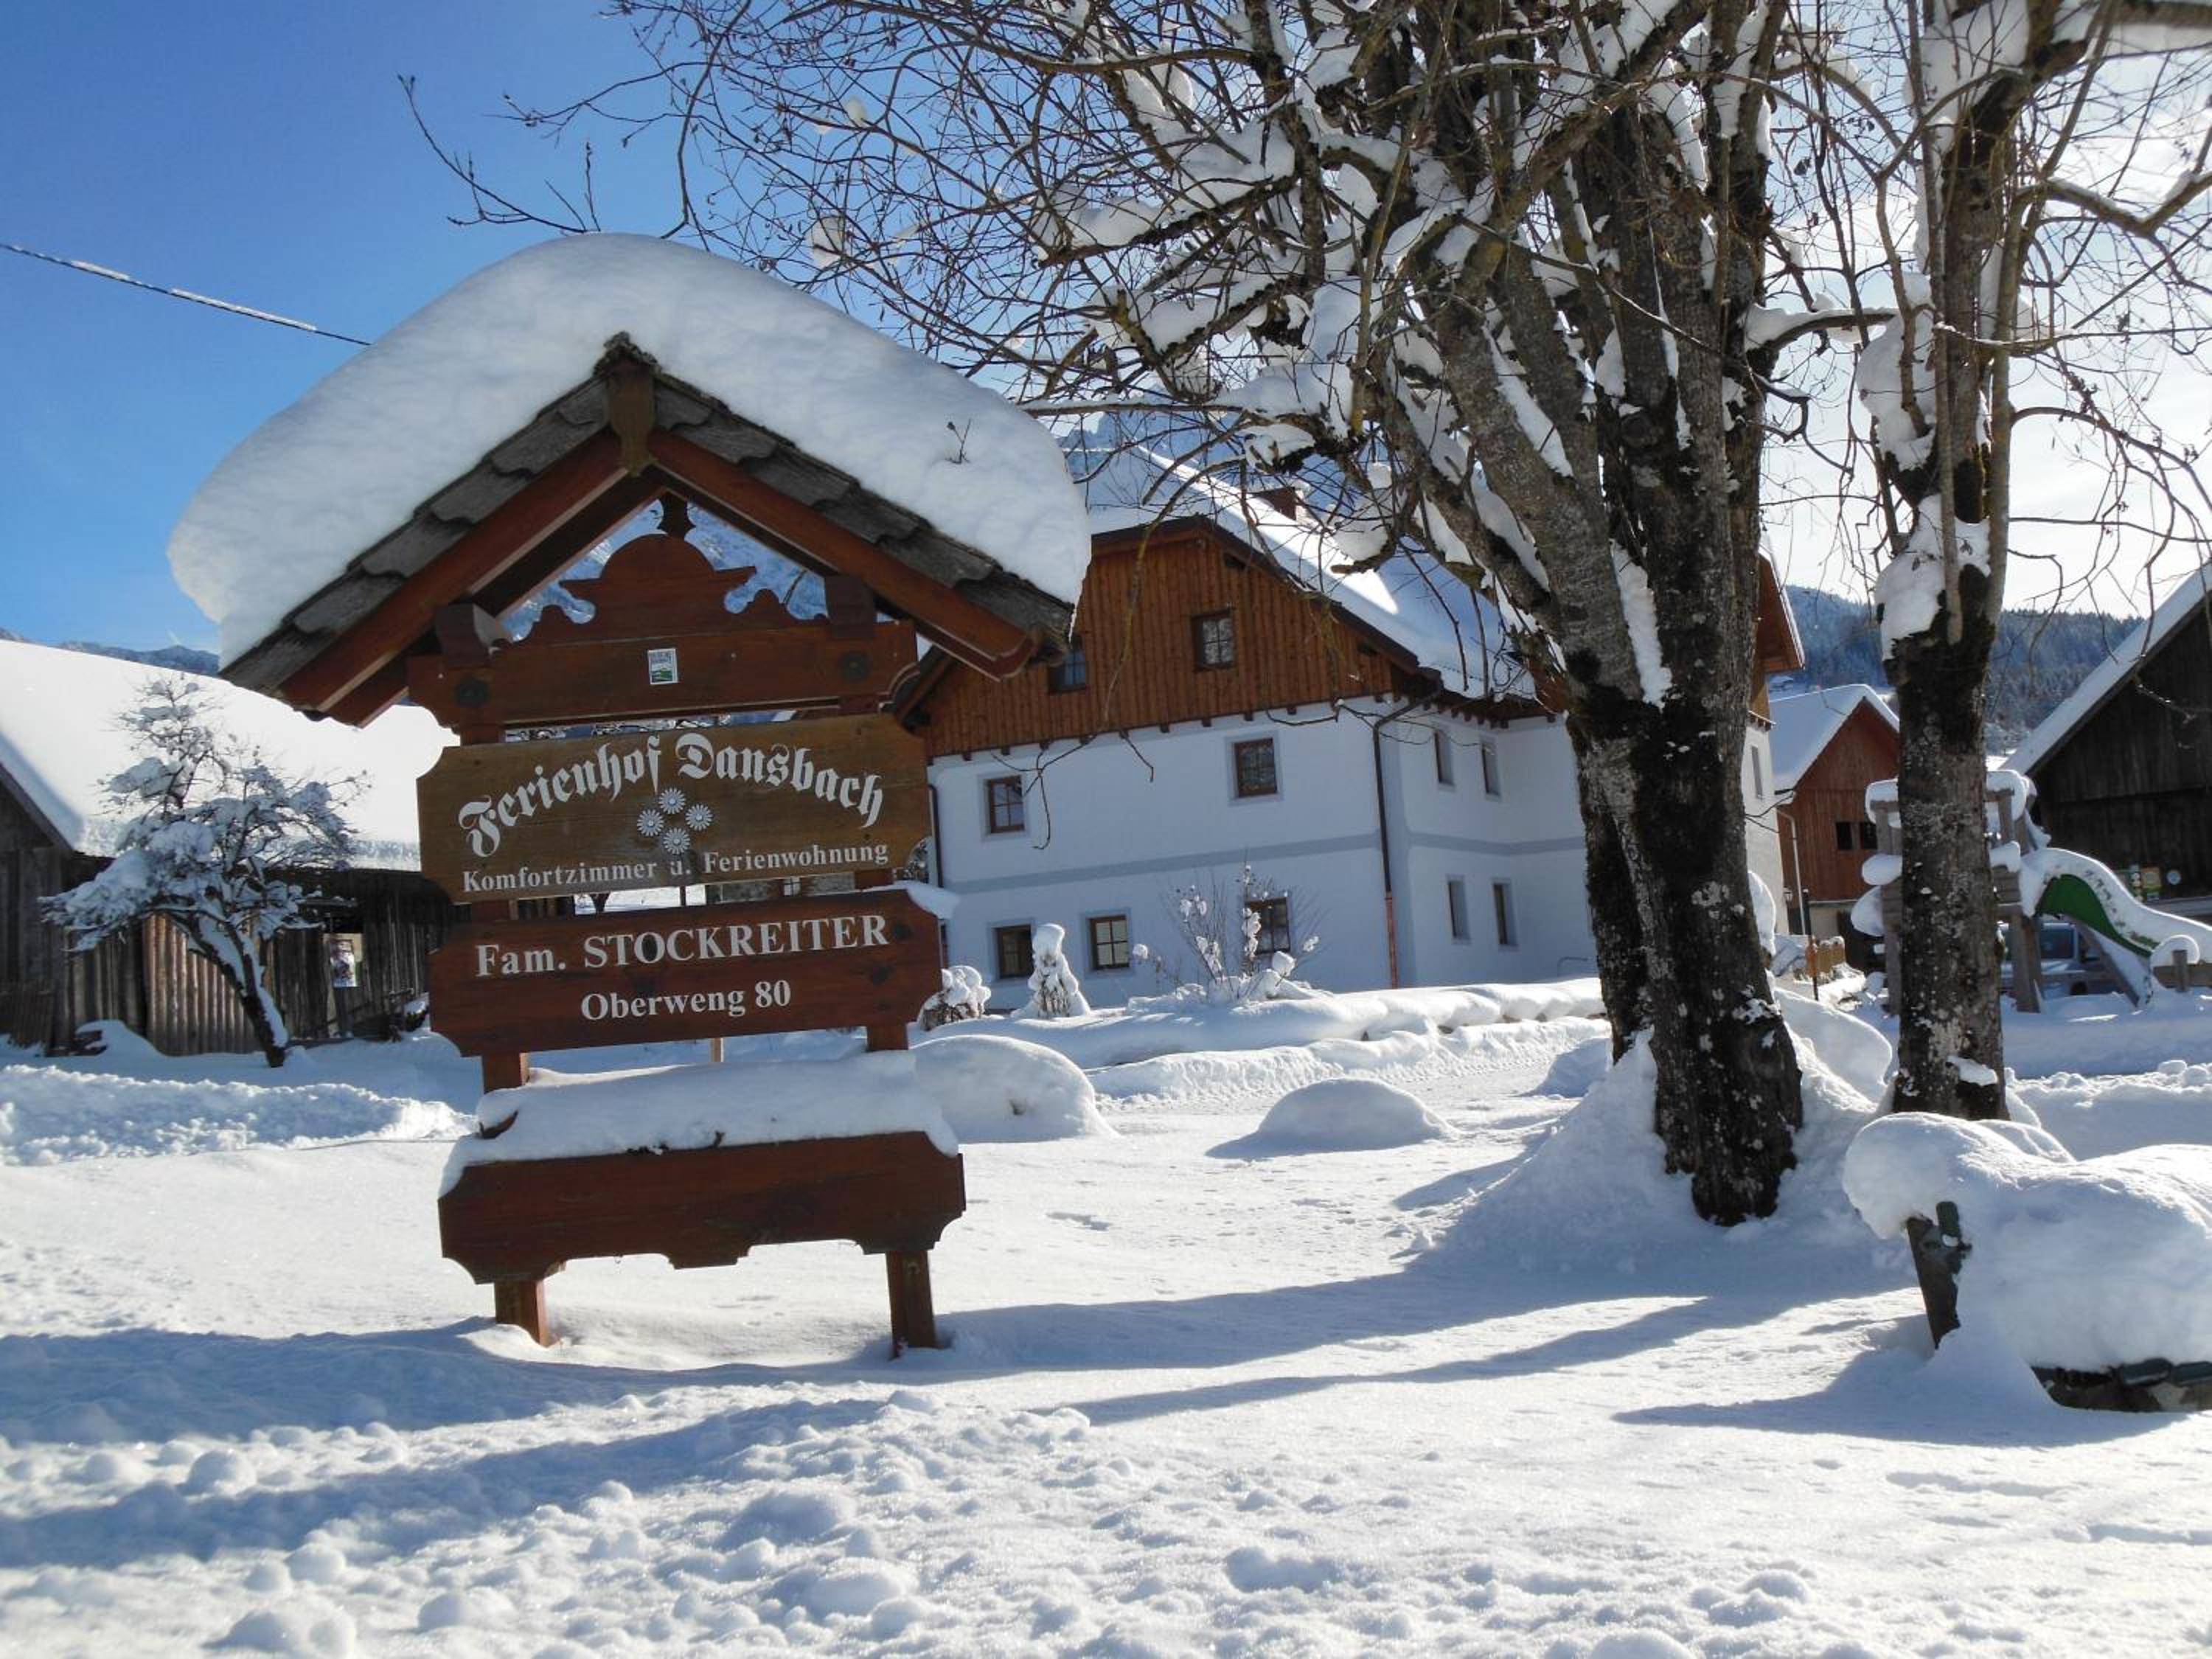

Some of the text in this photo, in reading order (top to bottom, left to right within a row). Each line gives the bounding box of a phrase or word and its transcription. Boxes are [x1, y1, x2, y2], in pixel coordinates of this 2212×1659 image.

[458, 732, 883, 858] Ferienhof Dansbach
[463, 861, 658, 892] Komfortzimmer
[704, 843, 888, 873] Ferienwohnung
[475, 915, 889, 977] Fam. STOCKREITER
[581, 979, 792, 1020] Oberweng 80
